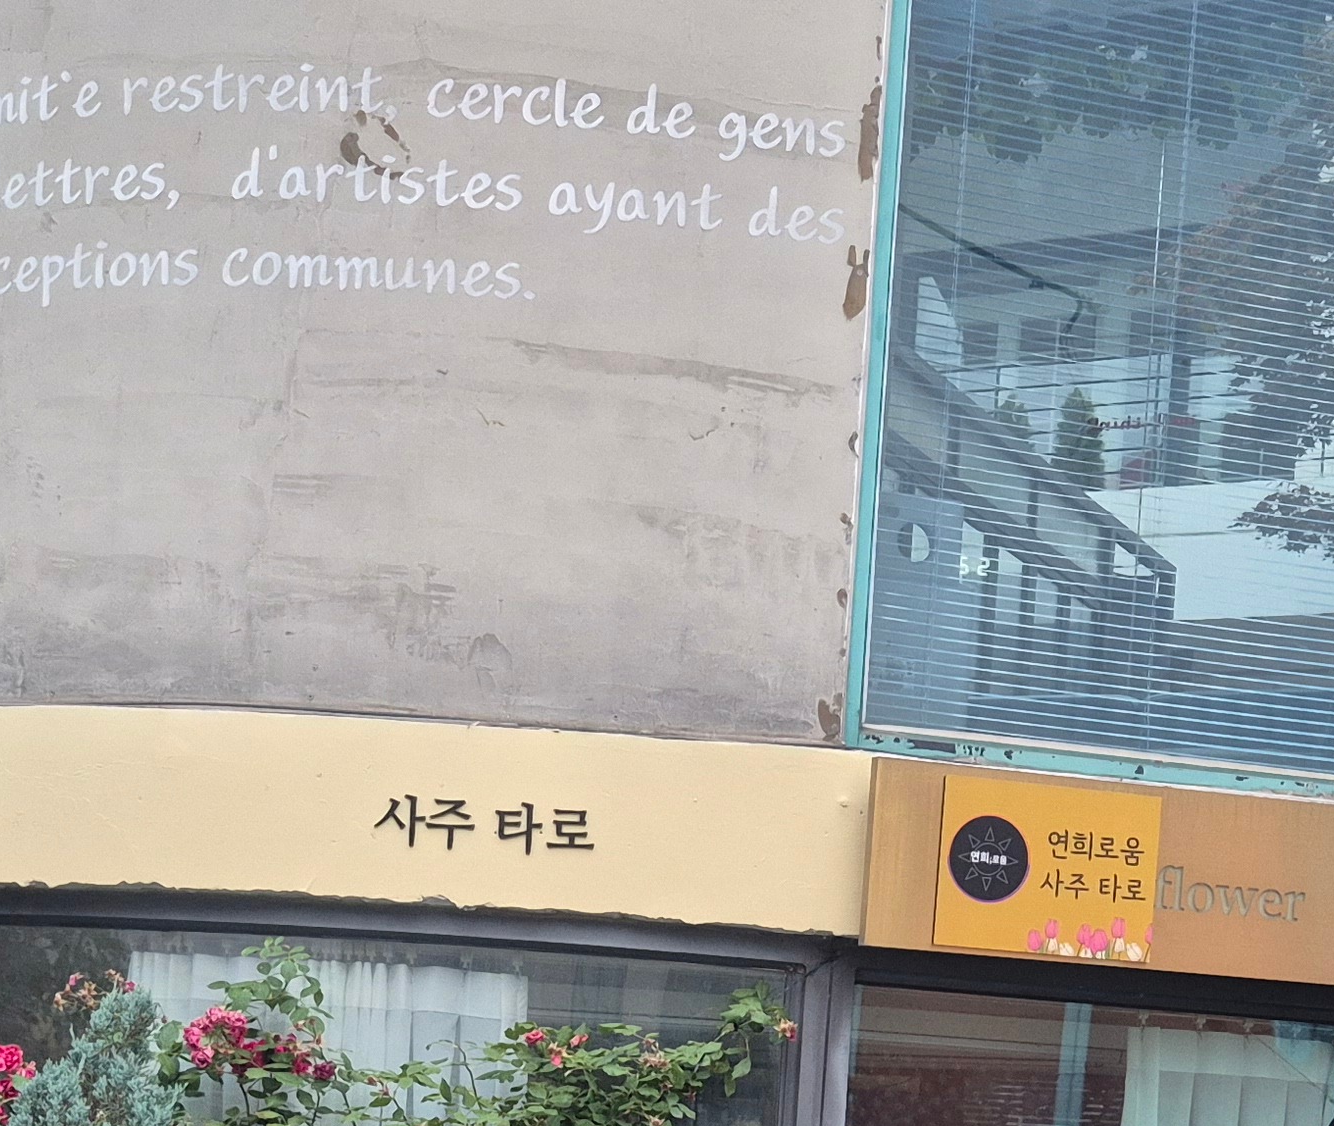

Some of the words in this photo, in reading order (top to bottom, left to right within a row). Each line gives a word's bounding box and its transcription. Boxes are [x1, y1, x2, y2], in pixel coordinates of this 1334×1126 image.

[426, 78, 605, 129] cercle
[625, 82, 696, 140] de
[717, 110, 847, 163] gens
[231, 144, 524, 212] d'artistes
[548, 180, 724, 235] ayant
[748, 186, 845, 245] des
[221, 246, 537, 301] communes.
[373, 794, 476, 851] 사주
[494, 801, 595, 856] 타로
[1047, 829, 1146, 867] 연희로움
[1039, 868, 1090, 900] 사주
[1099, 873, 1147, 904] 타로
[1155, 864, 1307, 923] flower
